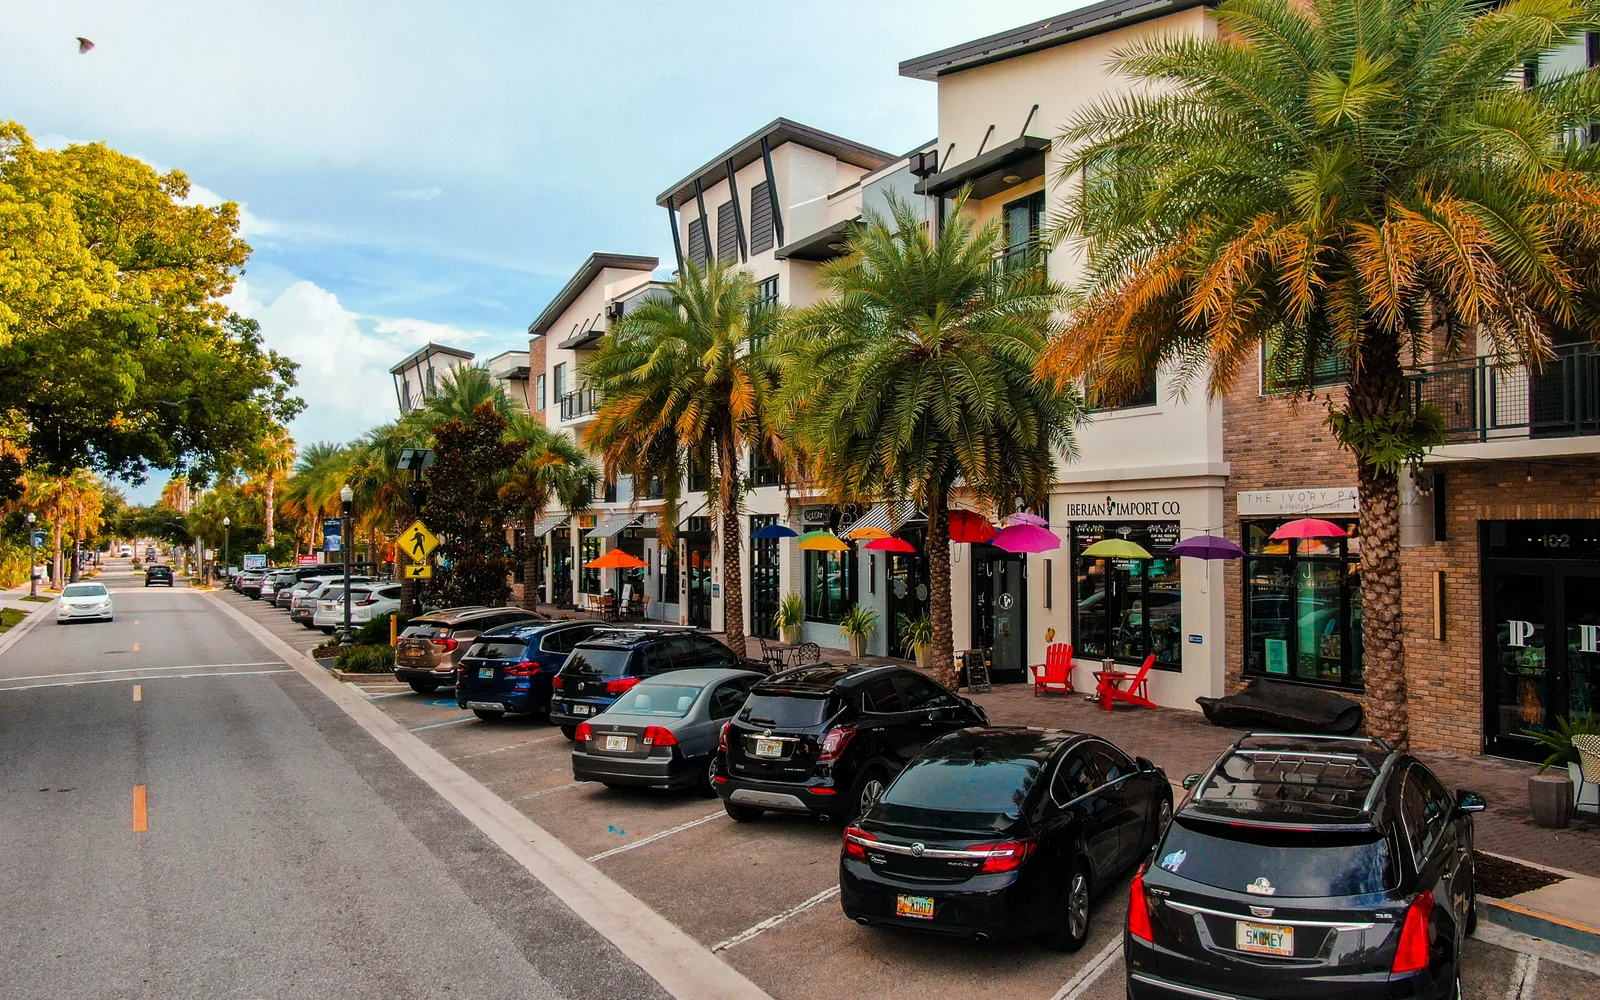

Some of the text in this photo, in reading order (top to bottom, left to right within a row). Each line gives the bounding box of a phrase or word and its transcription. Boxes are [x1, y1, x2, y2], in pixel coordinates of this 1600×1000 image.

[1247, 493, 1271, 503] THE
[1281, 491, 1327, 502] IVORY
[1066, 501, 1181, 516] IBERIAN IMPORT CO.
[1284, 502, 1309, 510] lifestyle
[1541, 534, 1570, 547] 102
[1246, 930, 1284, 948] SMOKEY
